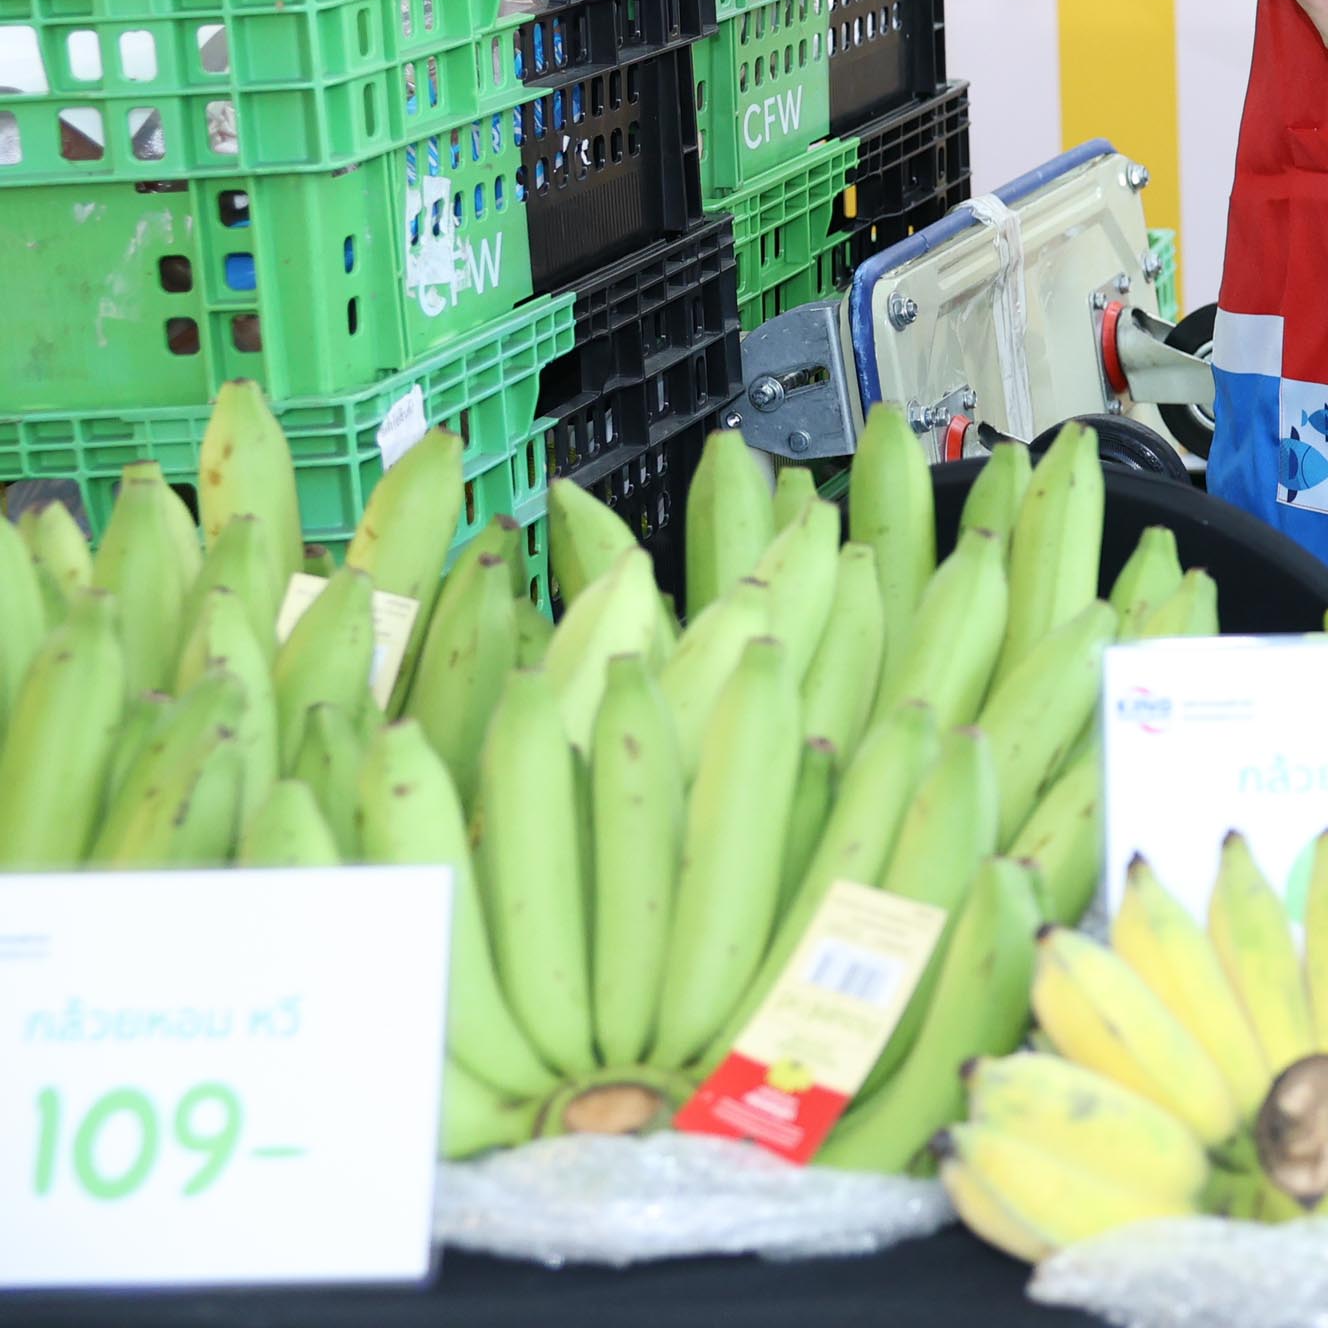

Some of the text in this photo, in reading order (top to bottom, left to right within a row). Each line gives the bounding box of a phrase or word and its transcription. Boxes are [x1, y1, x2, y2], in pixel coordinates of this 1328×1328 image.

[742, 85, 803, 150] CFW
[22, 994, 306, 1045] กล้วยหอม หวี
